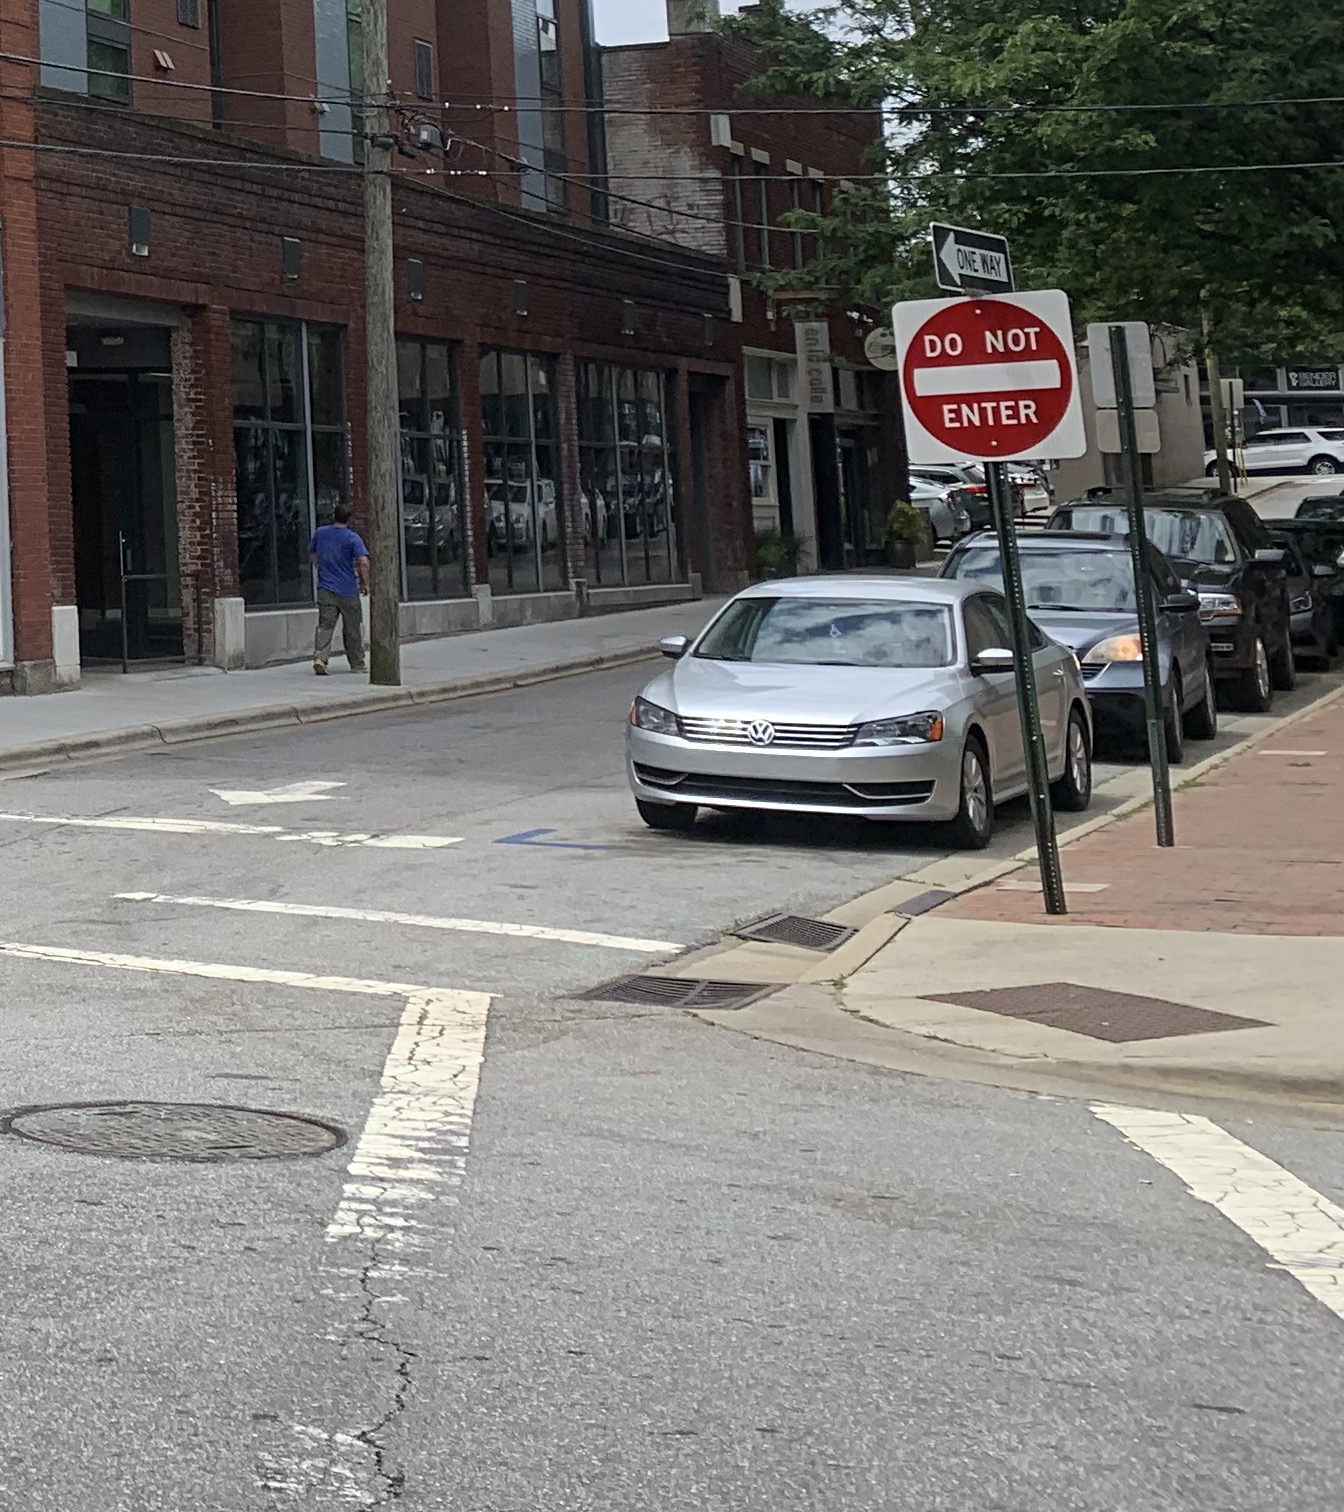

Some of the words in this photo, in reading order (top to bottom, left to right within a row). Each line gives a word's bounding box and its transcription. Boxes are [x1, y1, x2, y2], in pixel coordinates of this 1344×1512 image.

[956, 248, 979, 273] ONE
[980, 253, 1002, 278] WAY
[924, 333, 963, 358] DO
[984, 327, 1040, 354] NOT
[942, 399, 1039, 428] ENTER
